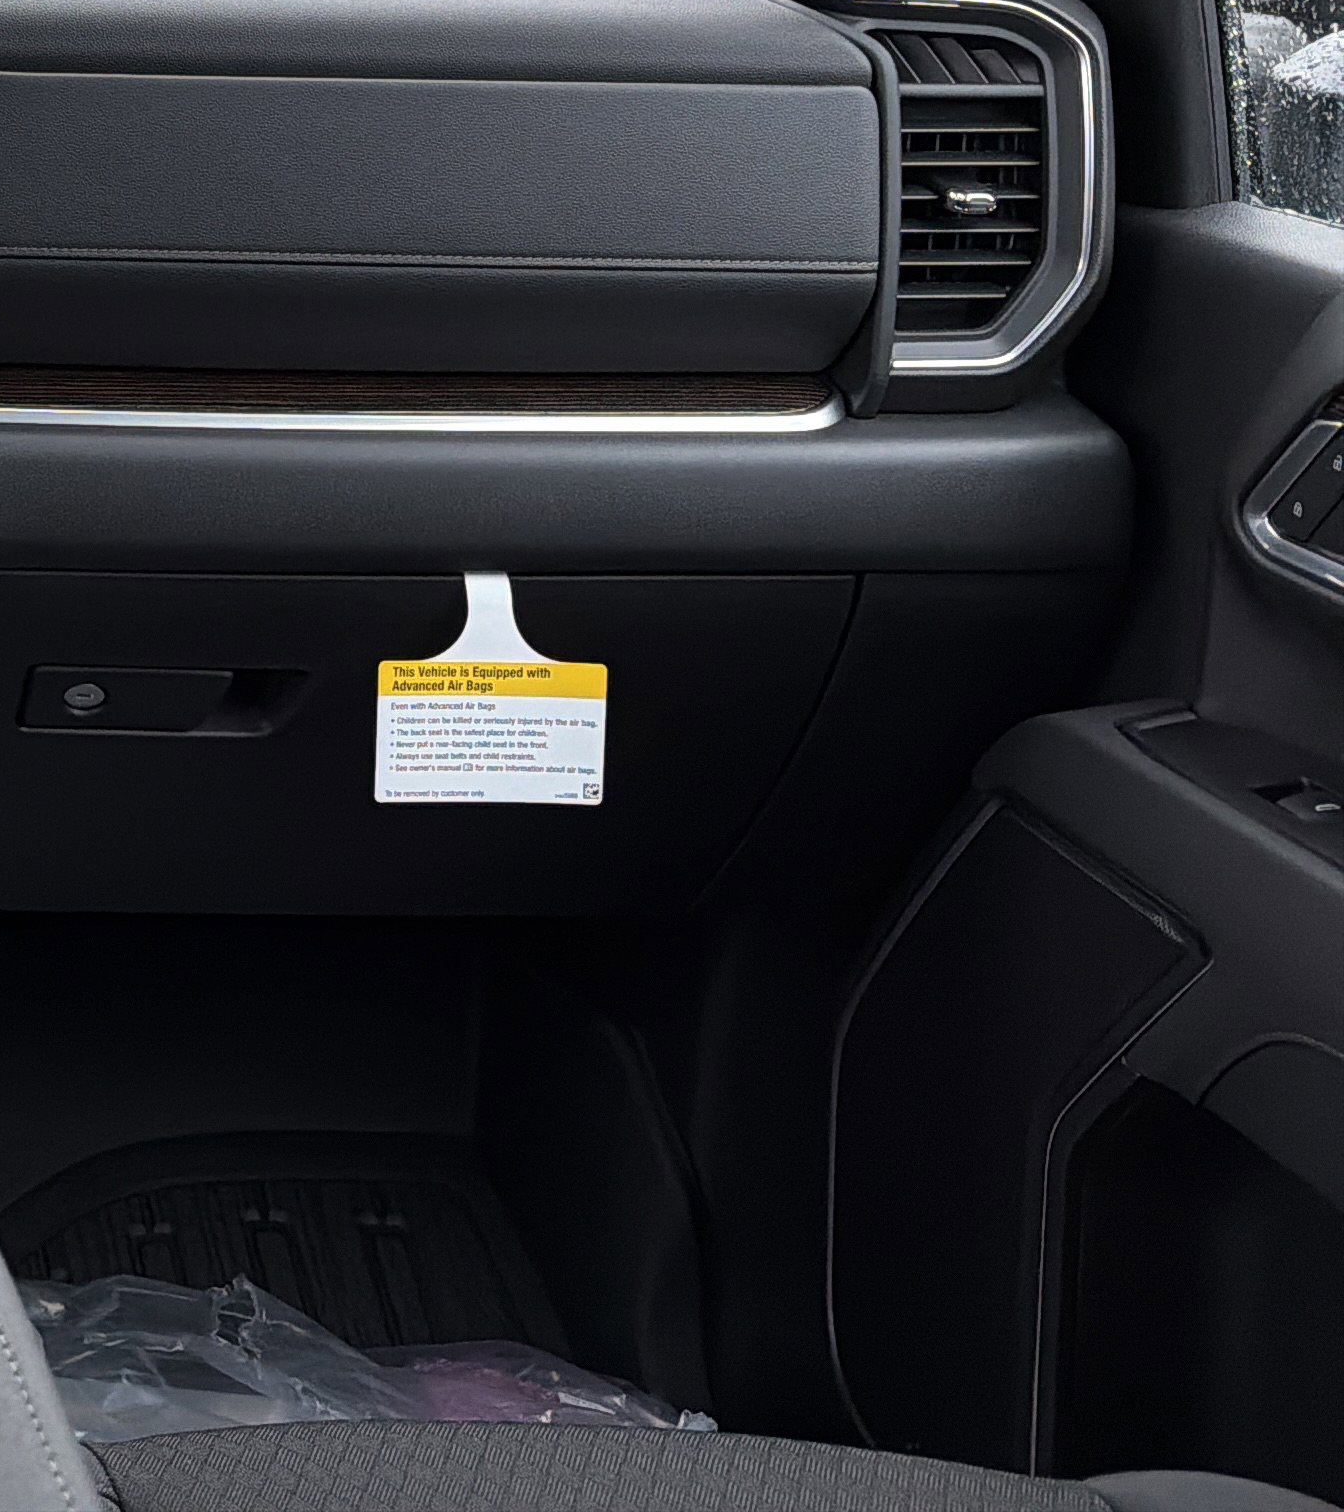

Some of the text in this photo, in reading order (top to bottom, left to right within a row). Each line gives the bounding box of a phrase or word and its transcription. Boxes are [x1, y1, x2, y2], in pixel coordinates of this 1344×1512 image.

[393, 666, 551, 680] This Vehicle is Equipped with
[392, 680, 494, 694] Advanced Air Bags
[391, 702, 496, 712] Even with Advanced Air Bags
[397, 717, 425, 725] Children
[442, 717, 451, 725] be
[453, 717, 472, 725] killed
[483, 718, 516, 726] seriously
[517, 718, 543, 727] injured
[544, 718, 553, 727] by
[555, 719, 568, 727] the
[569, 719, 580, 727] air
[581, 719, 598, 728] bag.
[486, 729, 505, 738] place
[507, 729, 516, 737] for
[518, 729, 548, 737] children.
